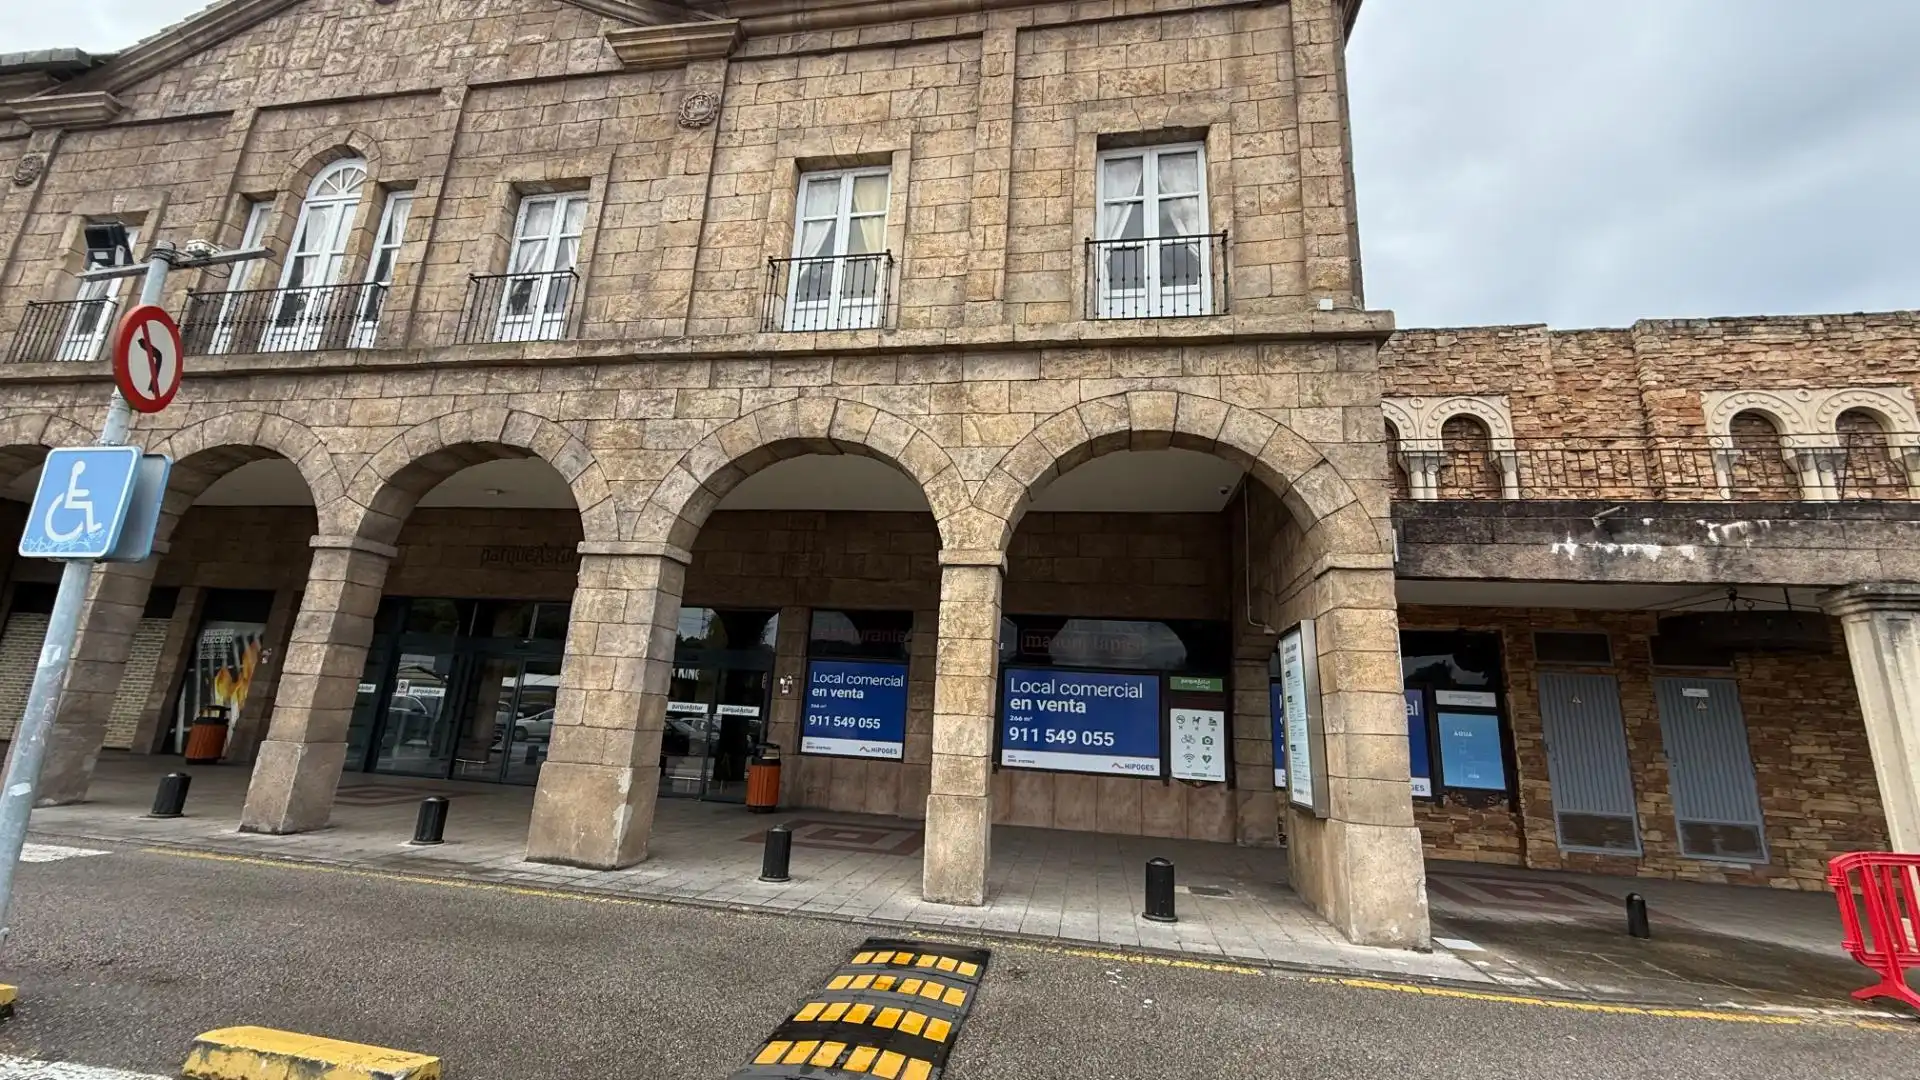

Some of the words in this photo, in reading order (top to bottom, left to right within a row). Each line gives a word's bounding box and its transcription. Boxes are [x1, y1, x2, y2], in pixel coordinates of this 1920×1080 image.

[813, 671, 844, 684] Local
[846, 674, 904, 688] comercial
[811, 688, 827, 697] en
[830, 688, 864, 699] venta
[1010, 677, 1055, 694] Local
[1059, 682, 1143, 699] comercial
[1010, 698, 1032, 711] en
[1036, 699, 1087, 714] venta
[809, 714, 830, 727] 911
[833, 715, 856, 728] 549
[858, 717, 881, 729] 055
[1009, 726, 1038, 742] 911
[1045, 728, 1077, 744] 549
[1082, 731, 1114, 747] 055
